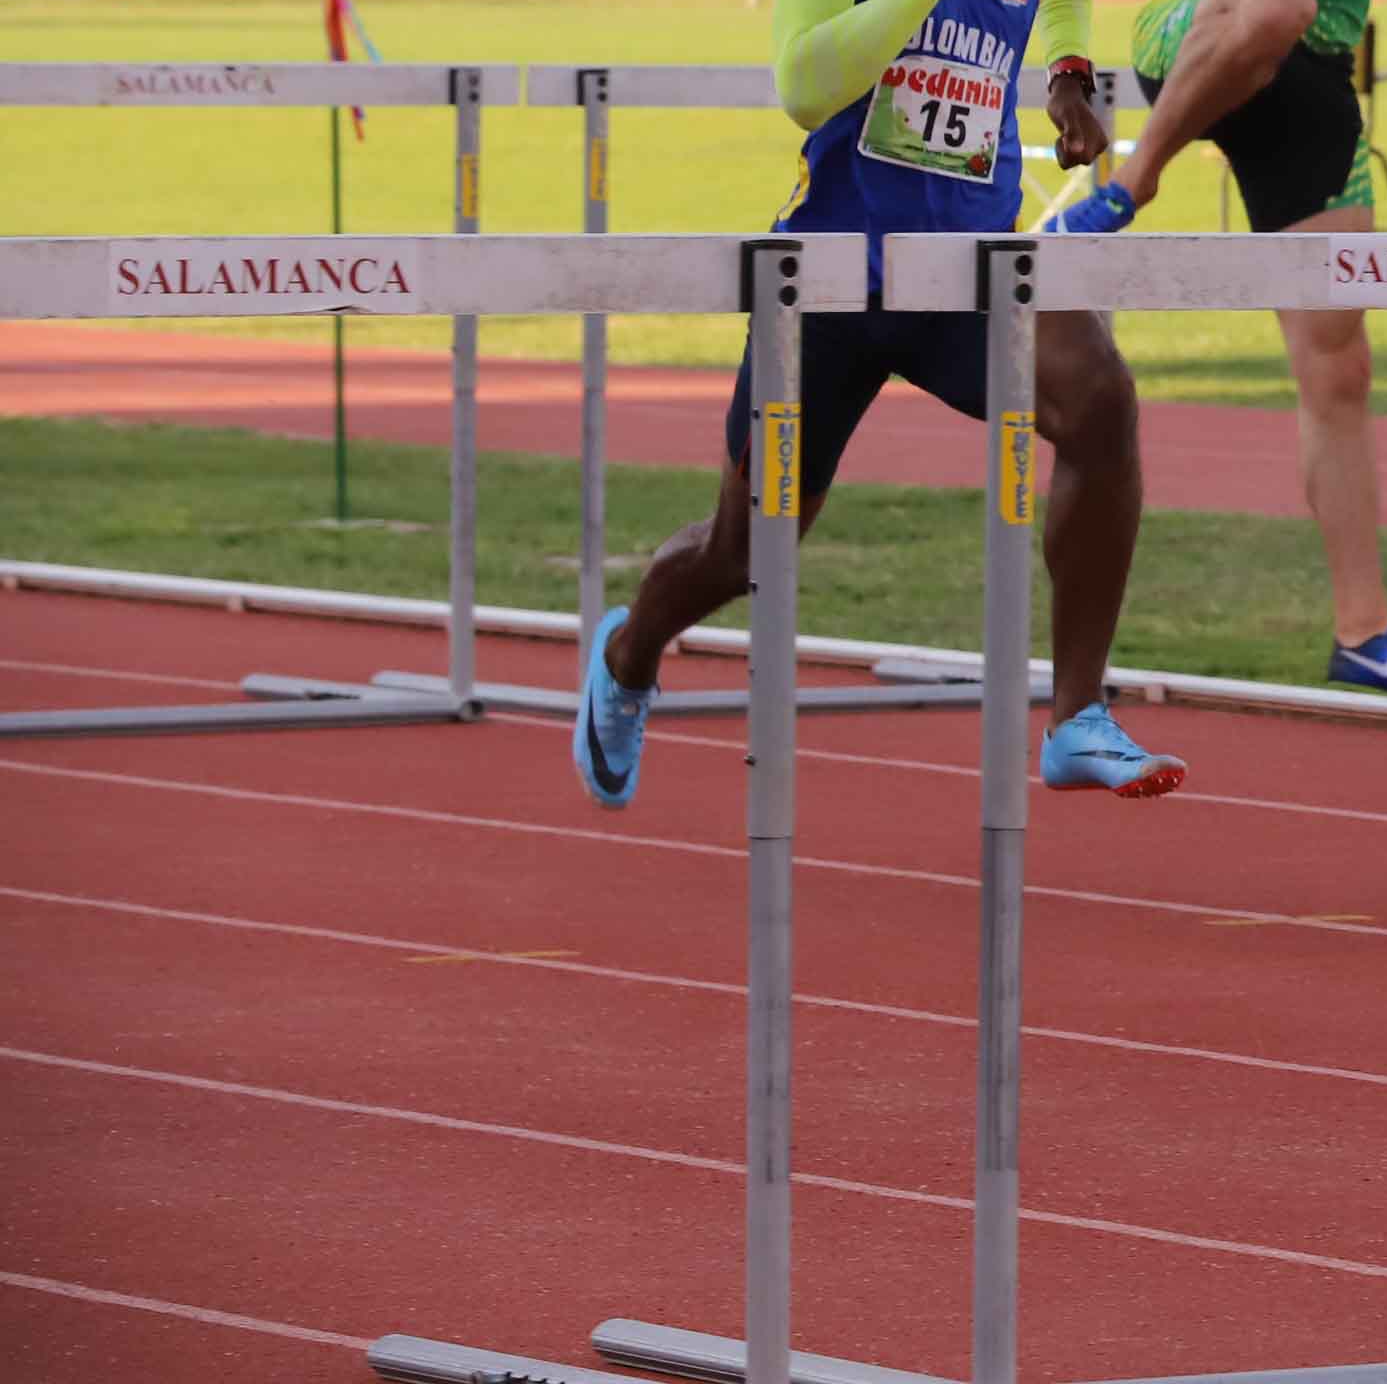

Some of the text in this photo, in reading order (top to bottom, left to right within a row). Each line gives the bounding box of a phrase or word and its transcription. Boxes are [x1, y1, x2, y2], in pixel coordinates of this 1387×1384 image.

[880, 65, 1003, 110] bedunia
[920, 99, 970, 148] 15
[116, 257, 412, 296] SALAMANCA
